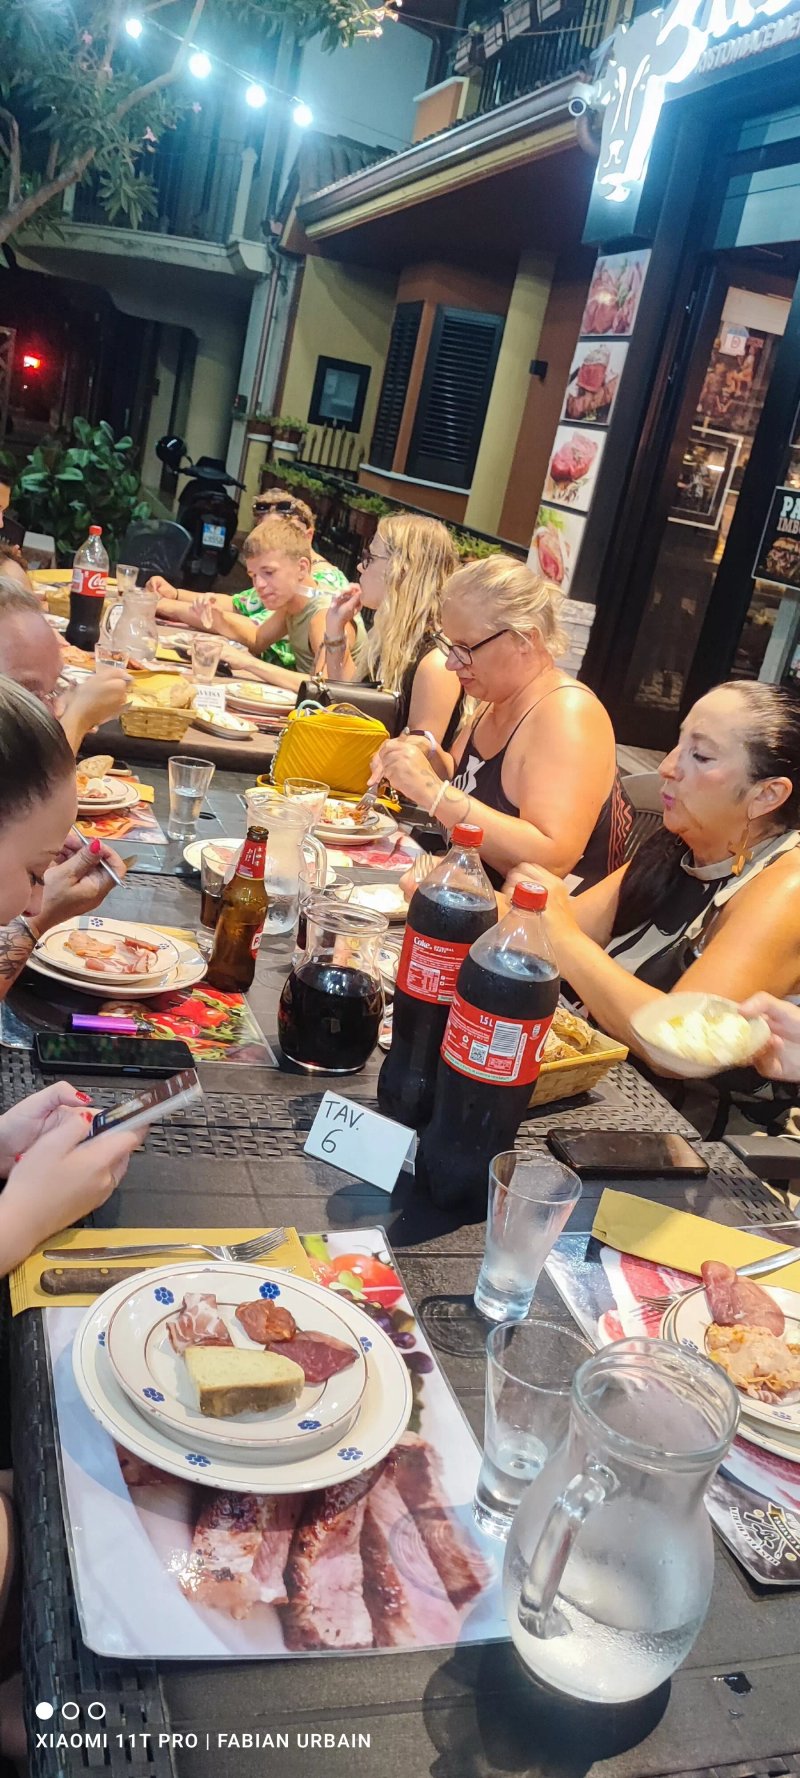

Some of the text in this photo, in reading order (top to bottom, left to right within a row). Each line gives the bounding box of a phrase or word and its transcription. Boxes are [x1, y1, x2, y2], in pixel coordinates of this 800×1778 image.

[777, 518, 800, 534] IMB
[324, 1100, 365, 1131] TAV.
[321, 1128, 344, 1154] 6
